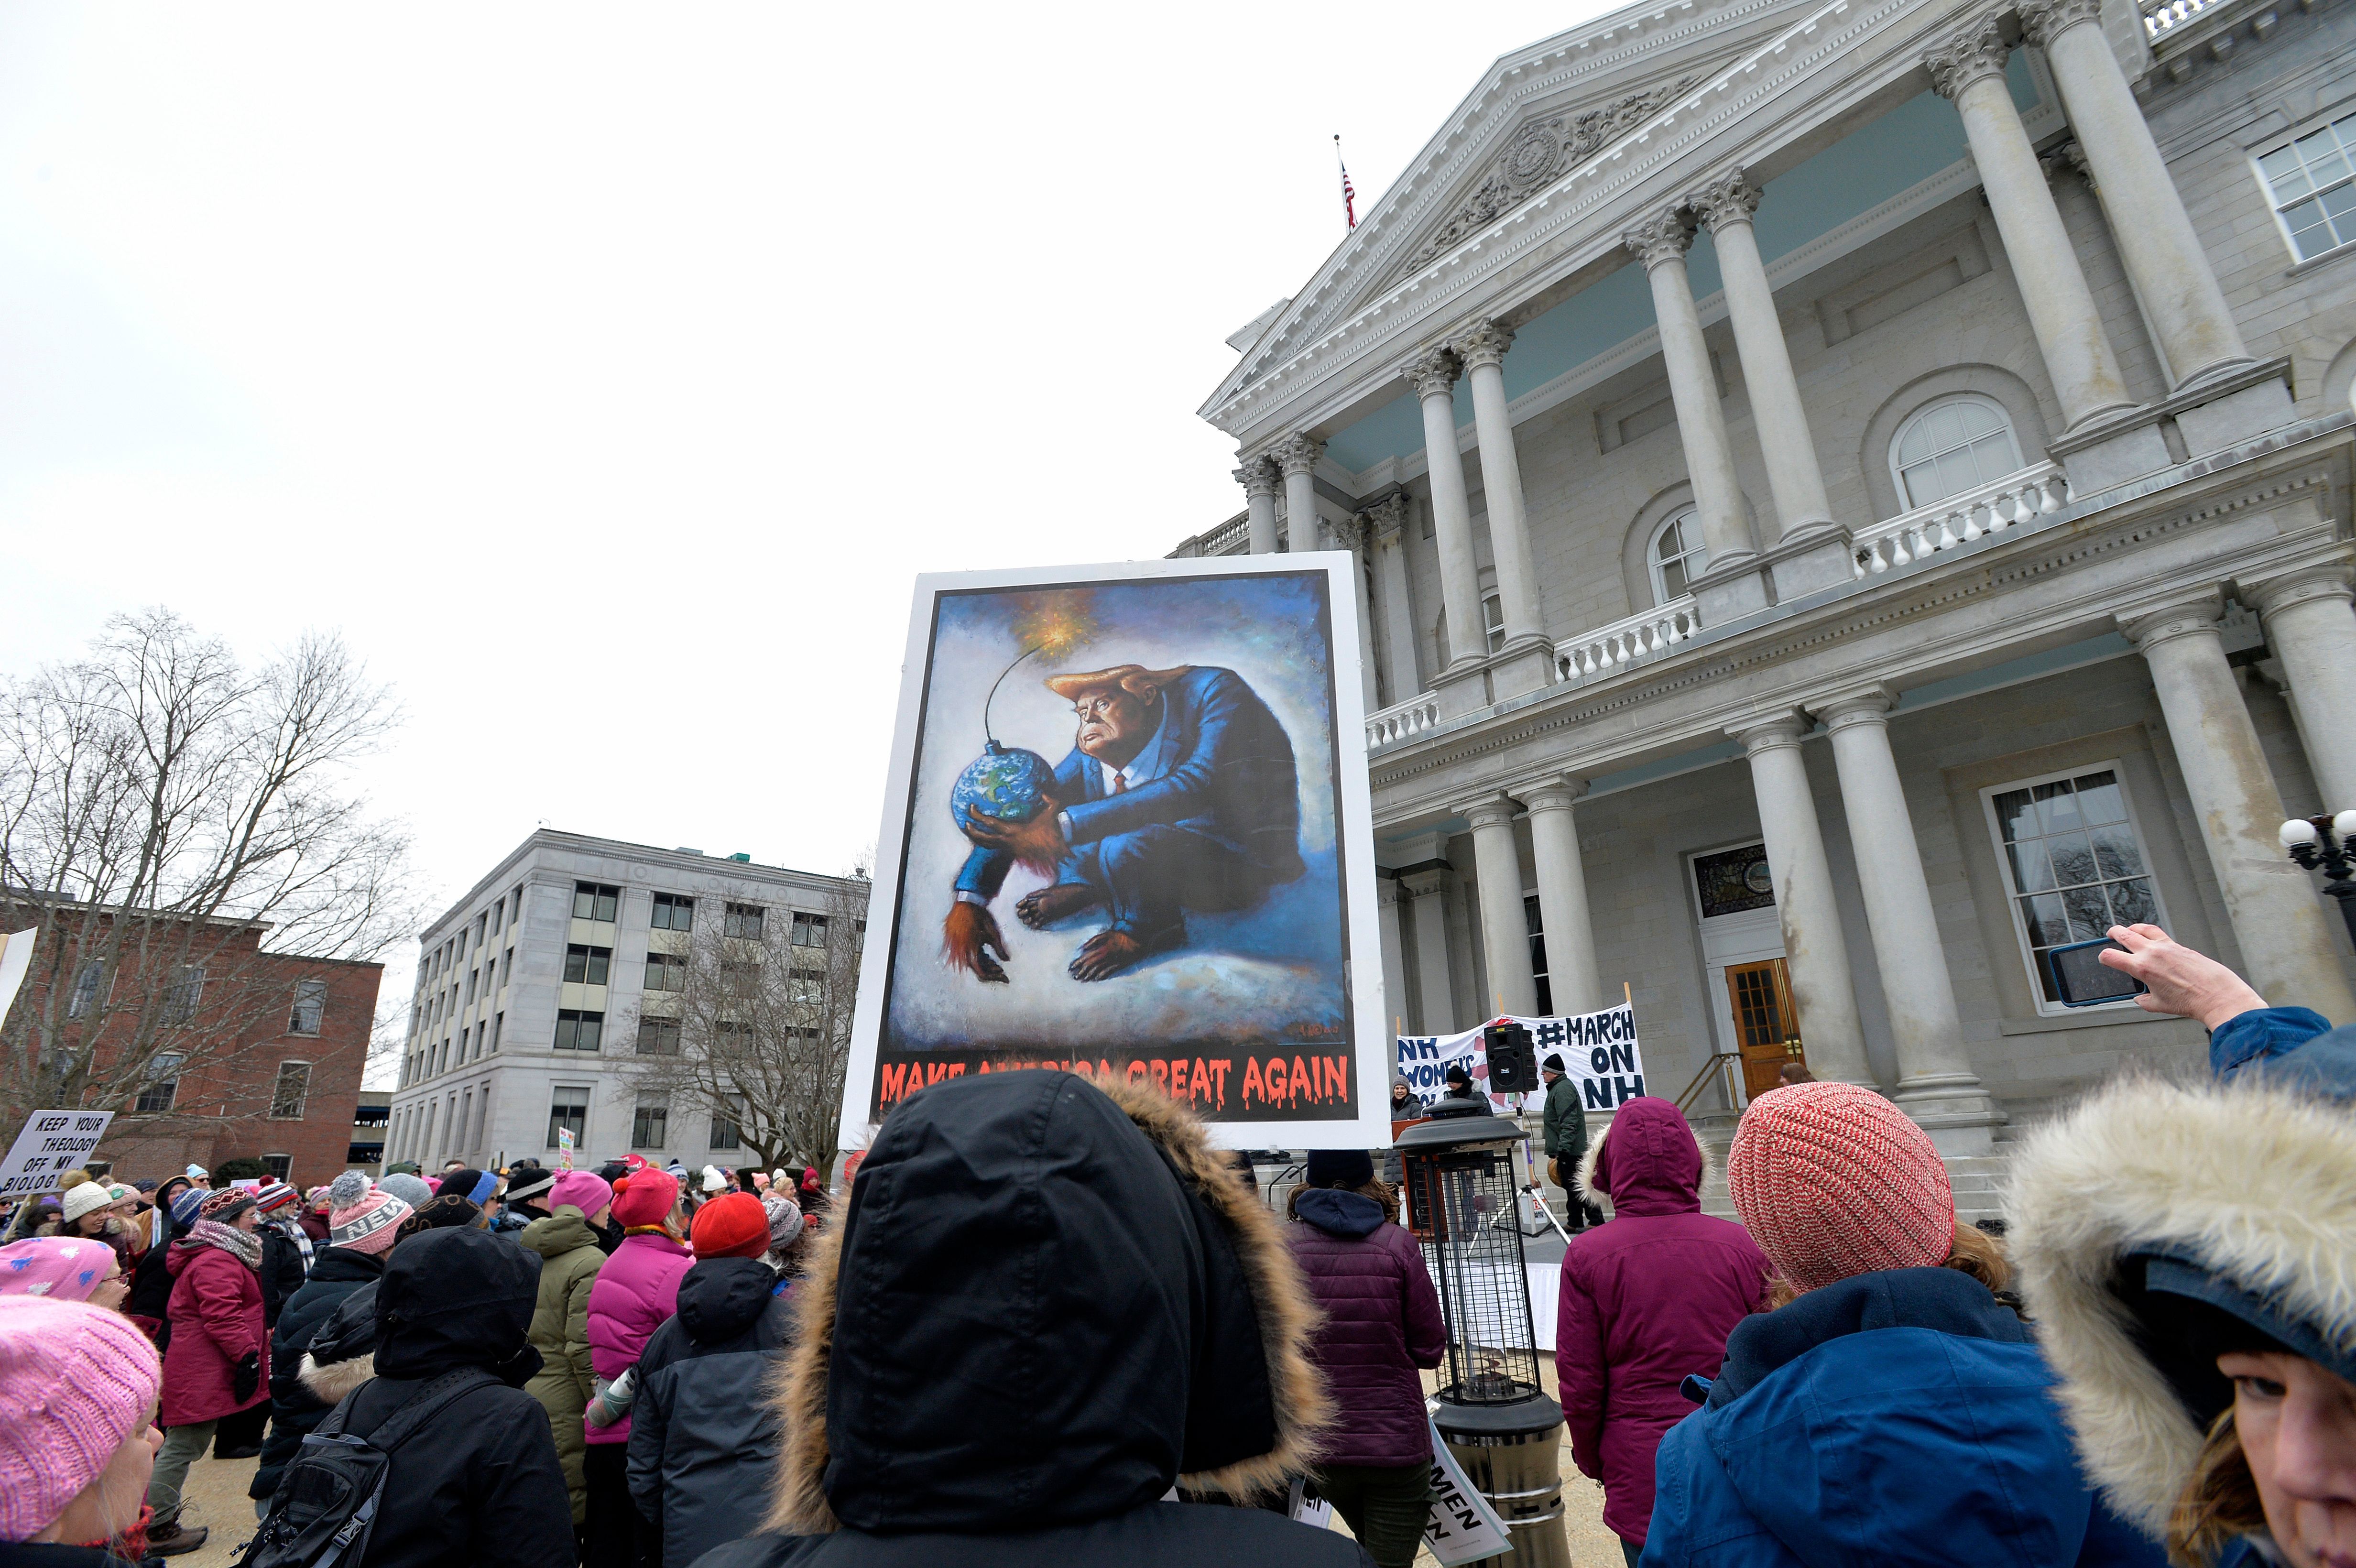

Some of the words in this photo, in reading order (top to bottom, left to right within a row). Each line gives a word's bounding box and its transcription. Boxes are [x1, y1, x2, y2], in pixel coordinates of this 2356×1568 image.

[1537, 1010, 1635, 1049] #MARCH
[1398, 1038, 1439, 1062] NH
[1591, 1044, 1635, 1074] ON
[1243, 1056, 1348, 1110] AGAIN
[1583, 1075, 1646, 1109] NH
[36, 1117, 68, 1131] KEEP
[75, 1117, 103, 1131] YOUR
[41, 1137, 99, 1152] THEOLOGY
[23, 1157, 49, 1172] OFF
[54, 1155, 76, 1170] MY
[346, 1199, 404, 1240] NEW
